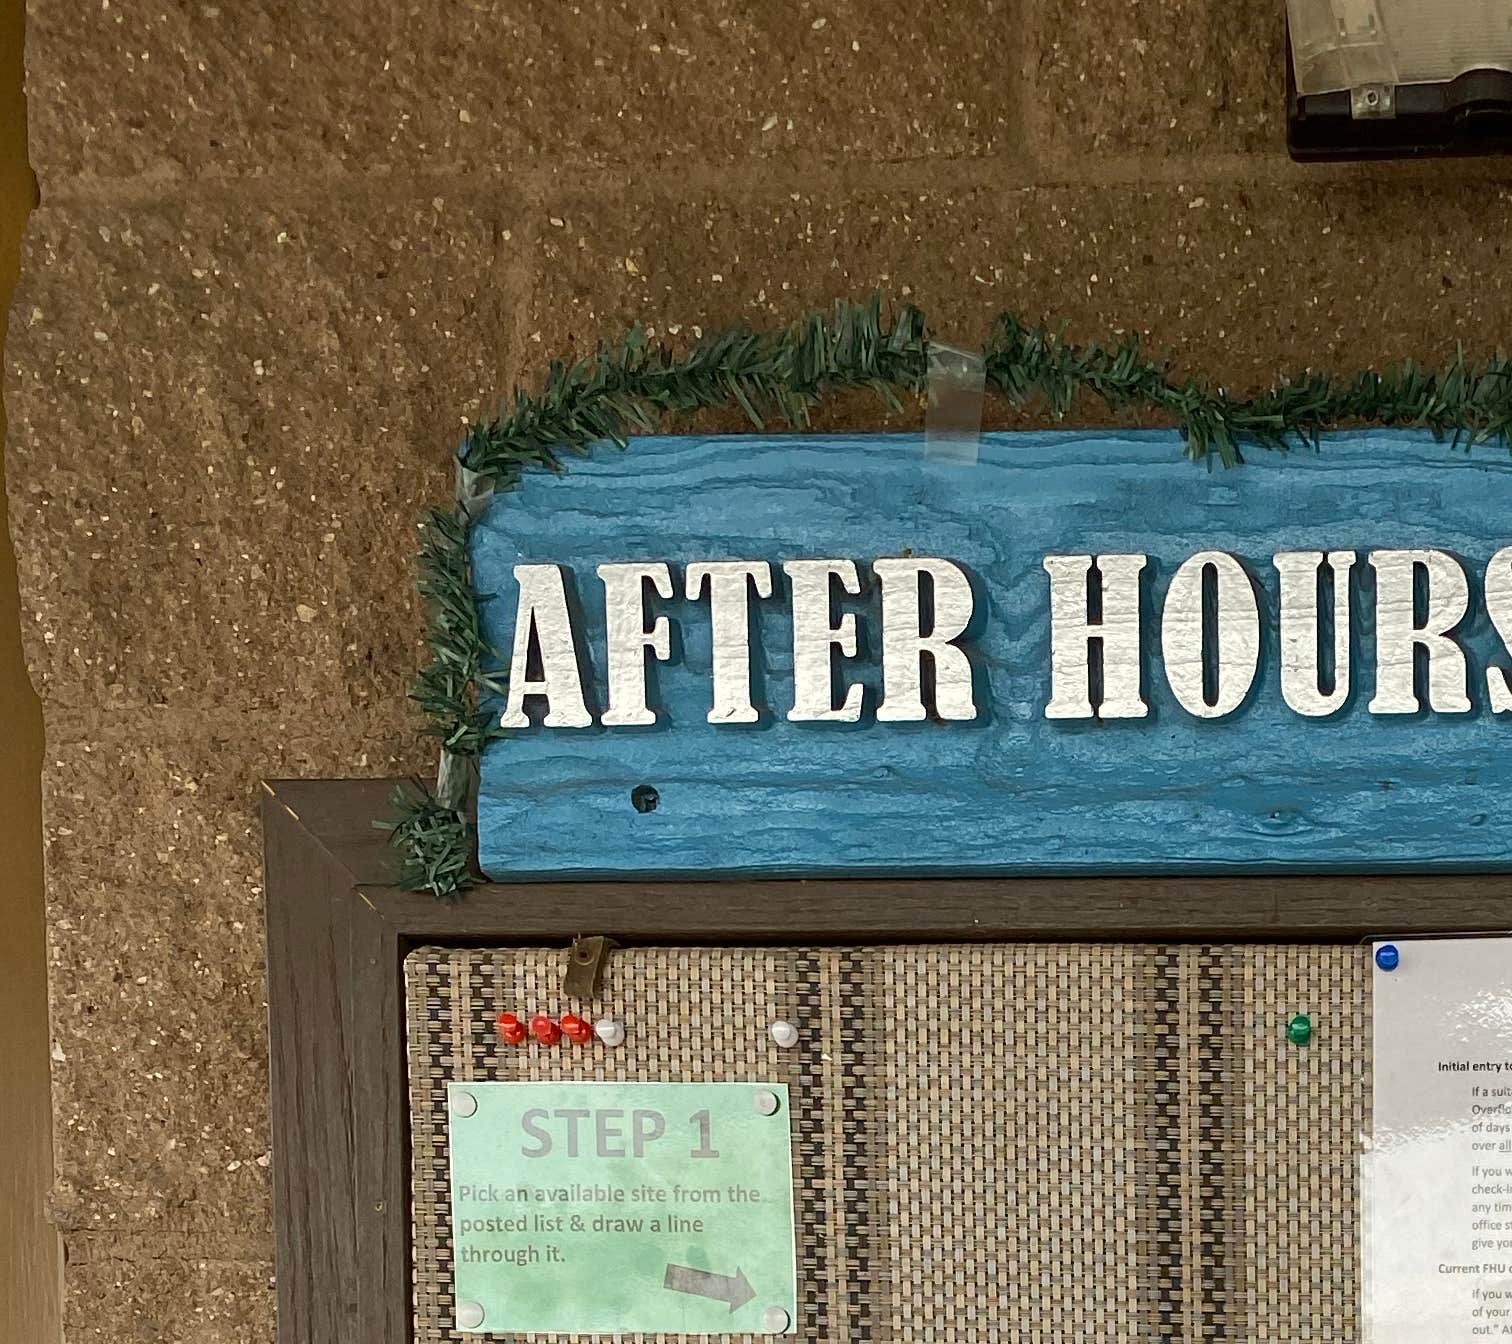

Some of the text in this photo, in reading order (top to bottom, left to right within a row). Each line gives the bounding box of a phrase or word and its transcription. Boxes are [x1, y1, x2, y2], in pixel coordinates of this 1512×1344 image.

[499, 555, 979, 729] AFTER
[1438, 1060, 1469, 1071] Initial
[1472, 1061, 1502, 1073] entry
[521, 1109, 720, 1159] STEP 1
[458, 1184, 761, 1203] Pick an available site from the
[459, 1213, 703, 1236] posted list & draw a line
[461, 1244, 565, 1266] through it.
[1438, 1263, 1480, 1273] Current
[1482, 1263, 1506, 1273] FHU
